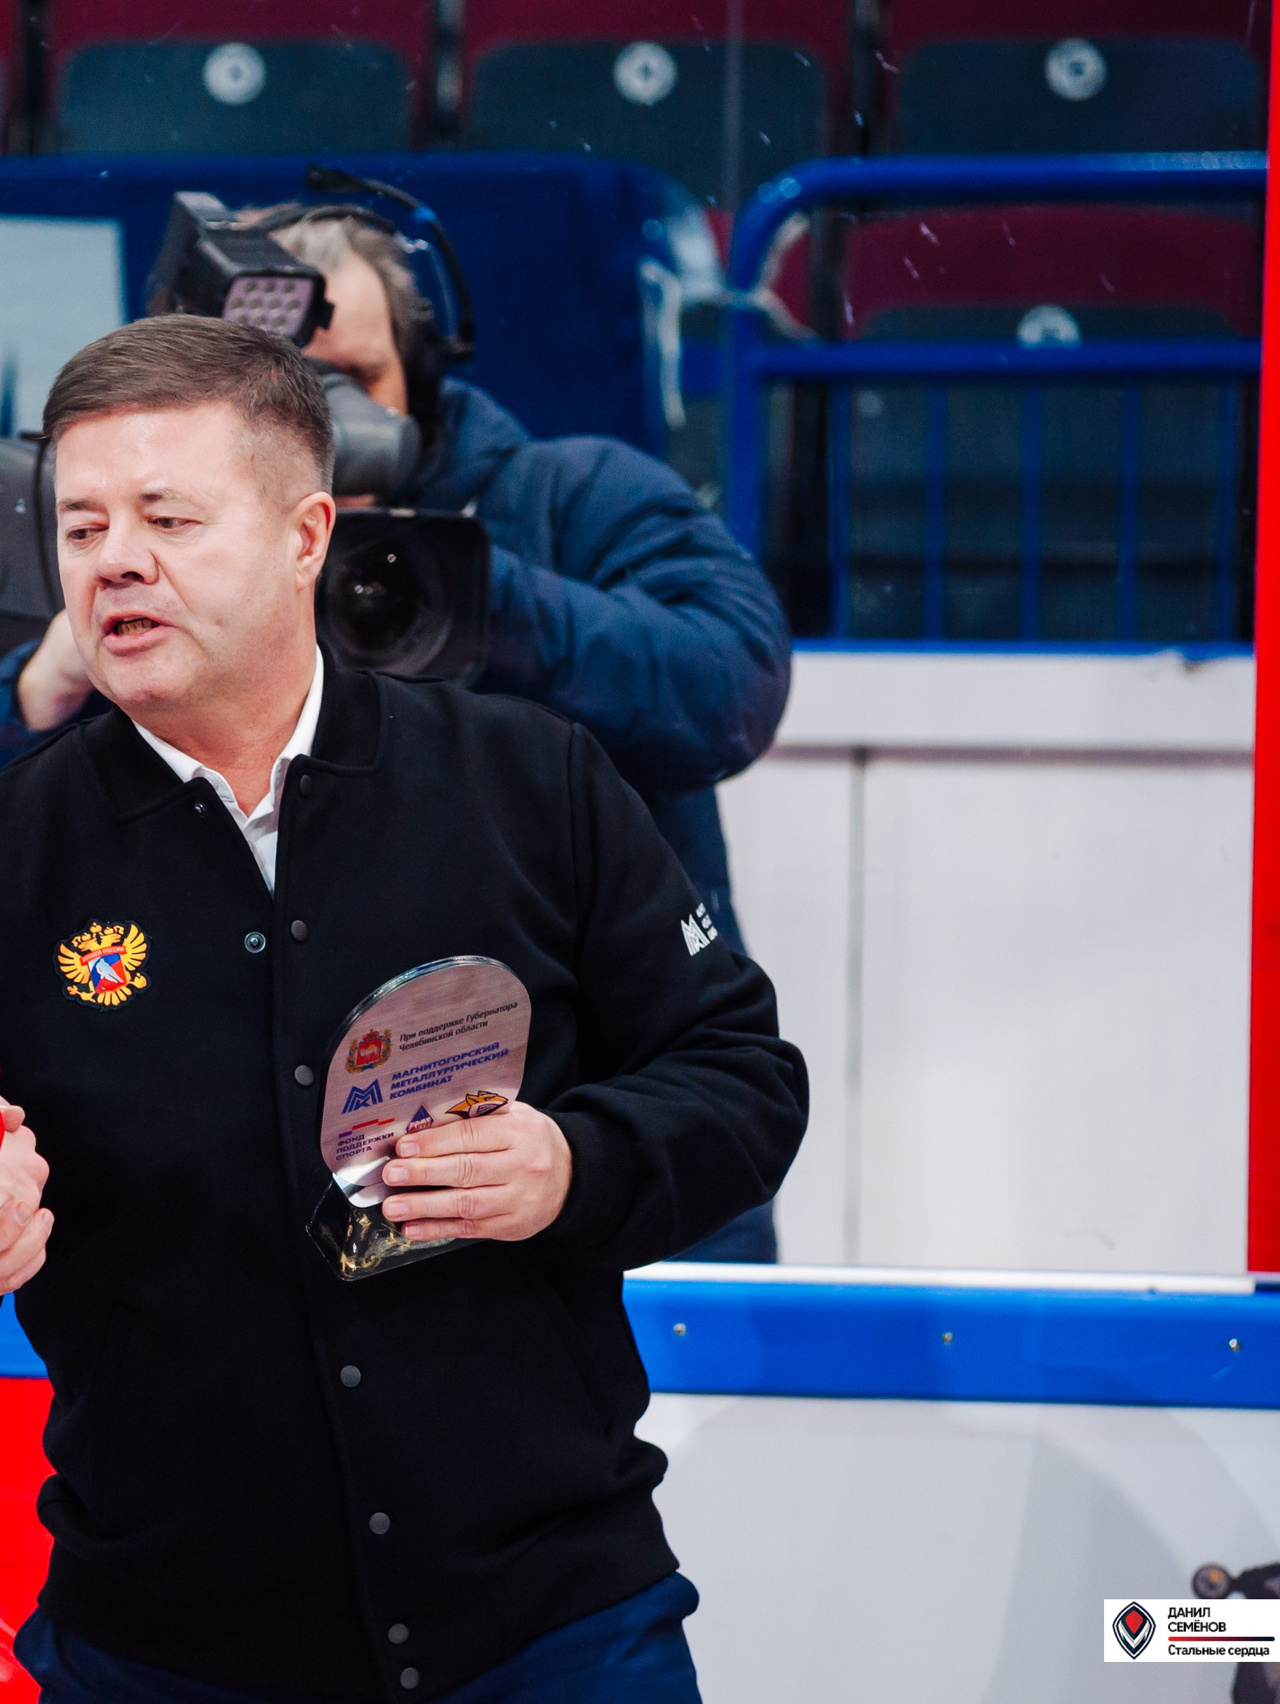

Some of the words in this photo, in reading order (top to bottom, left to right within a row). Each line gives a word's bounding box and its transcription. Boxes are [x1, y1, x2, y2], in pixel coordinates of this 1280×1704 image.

[399, 1030, 453, 1051] Челябинской
[455, 1020, 488, 1035] области
[400, 1032, 417, 1042] При
[418, 1018, 464, 1036] поддержке
[466, 1002, 518, 1022] Губернатора
[390, 1048, 509, 1090] МЕТАЛЛУРГИЧЕСКИЙ
[391, 1042, 500, 1080] МАГНИТОГОРСКИЙ
[389, 1075, 453, 1100] КОМБИНАТ
[335, 1146, 372, 1161] СПОРТА
[336, 1132, 394, 1153] ПОДДЕРЖКИ
[337, 1133, 365, 1146] ФОНД
